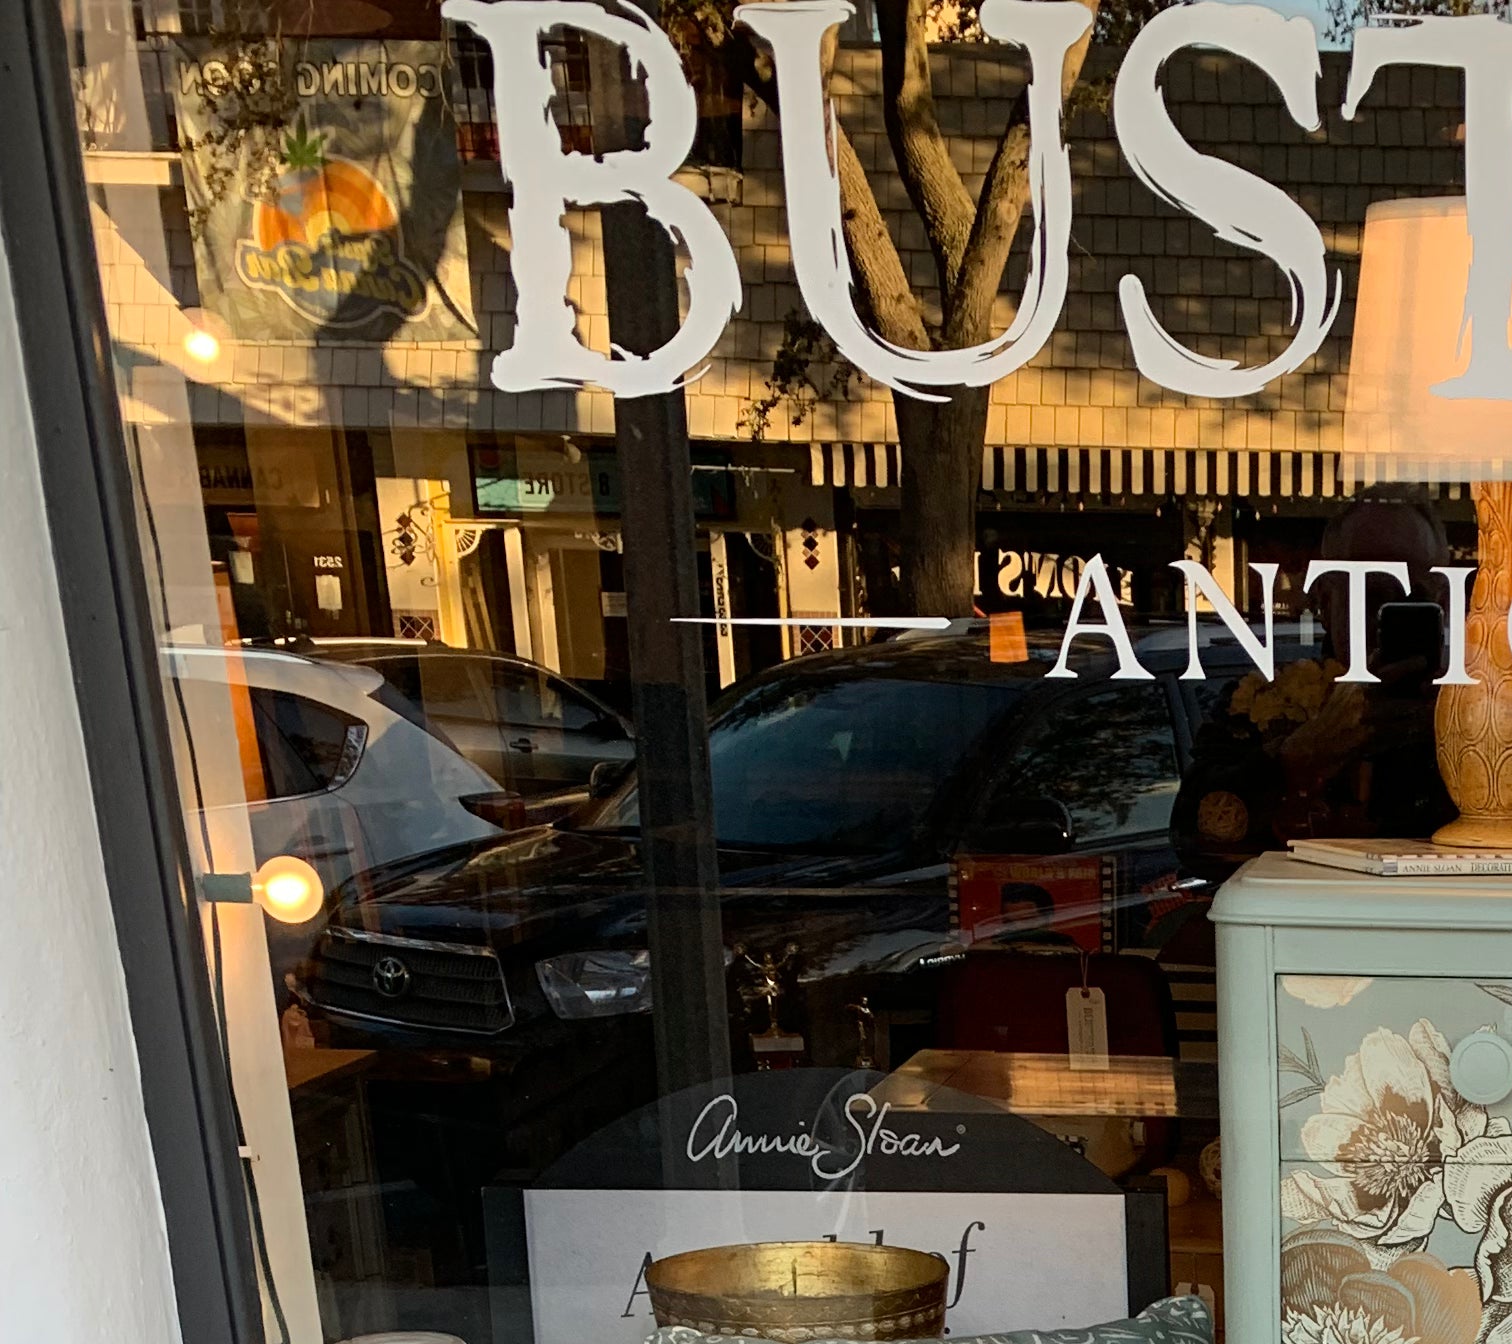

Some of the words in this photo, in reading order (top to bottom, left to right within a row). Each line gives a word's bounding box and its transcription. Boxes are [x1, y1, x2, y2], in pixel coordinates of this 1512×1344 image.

[1402, 864, 1430, 873] ANNIE
[1433, 863, 1462, 873] SLOAN
[686, 1093, 819, 1163] Annie
[930, 1221, 985, 1309] f
